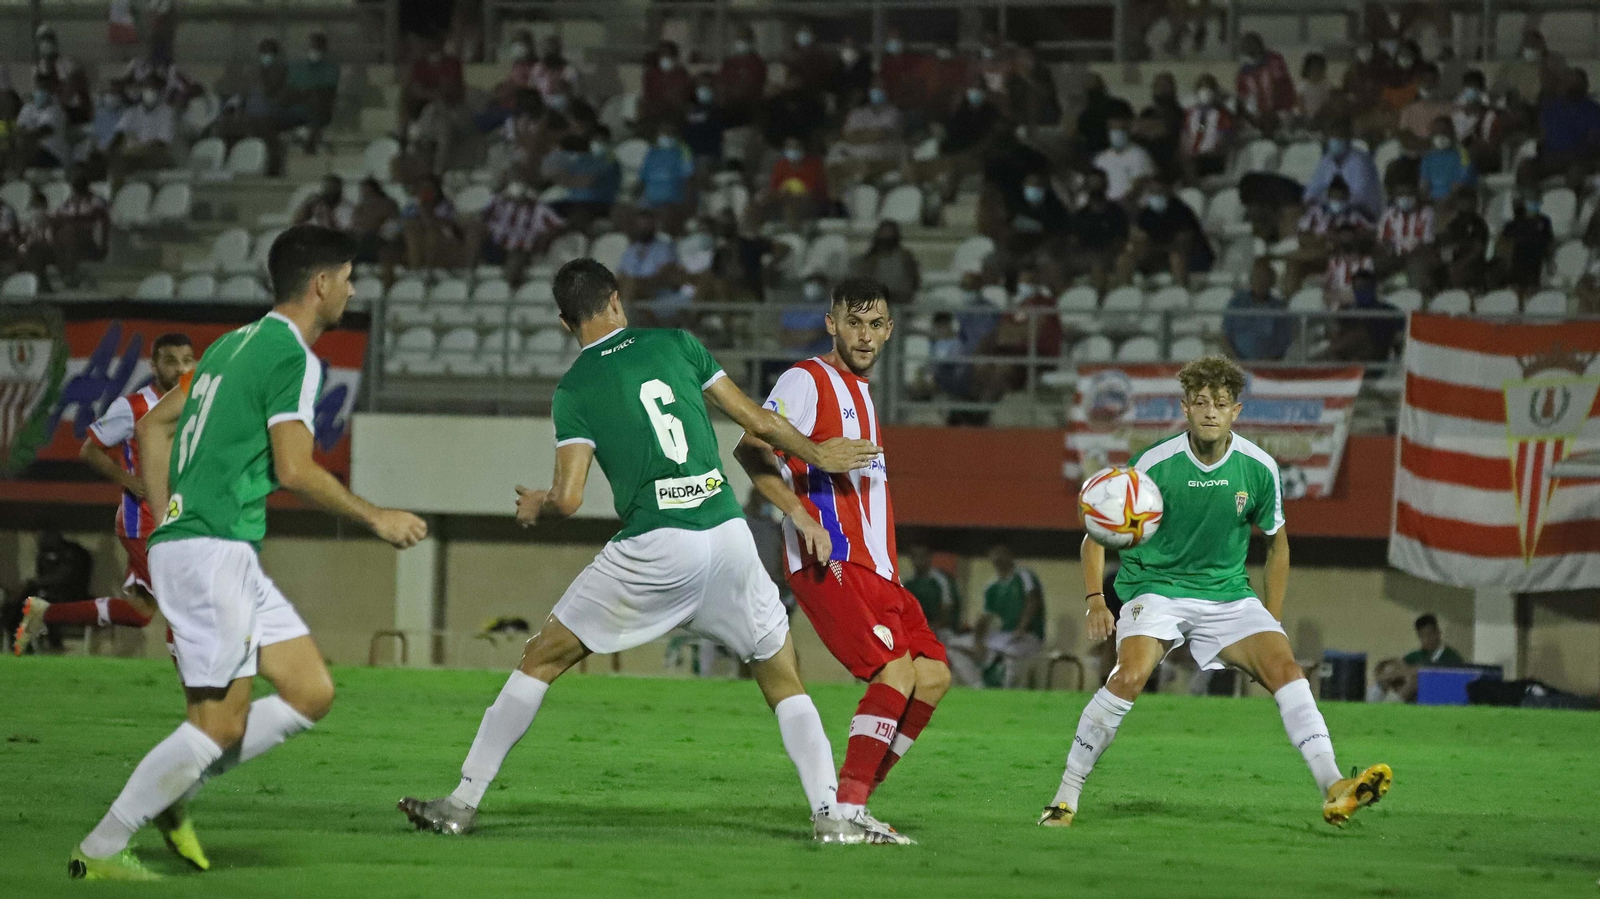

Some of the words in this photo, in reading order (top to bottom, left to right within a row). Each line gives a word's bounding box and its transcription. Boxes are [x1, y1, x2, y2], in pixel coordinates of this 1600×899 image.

[177, 372, 223, 475] 21
[639, 378, 689, 465] 6
[1188, 479, 1229, 488] GIVOVA
